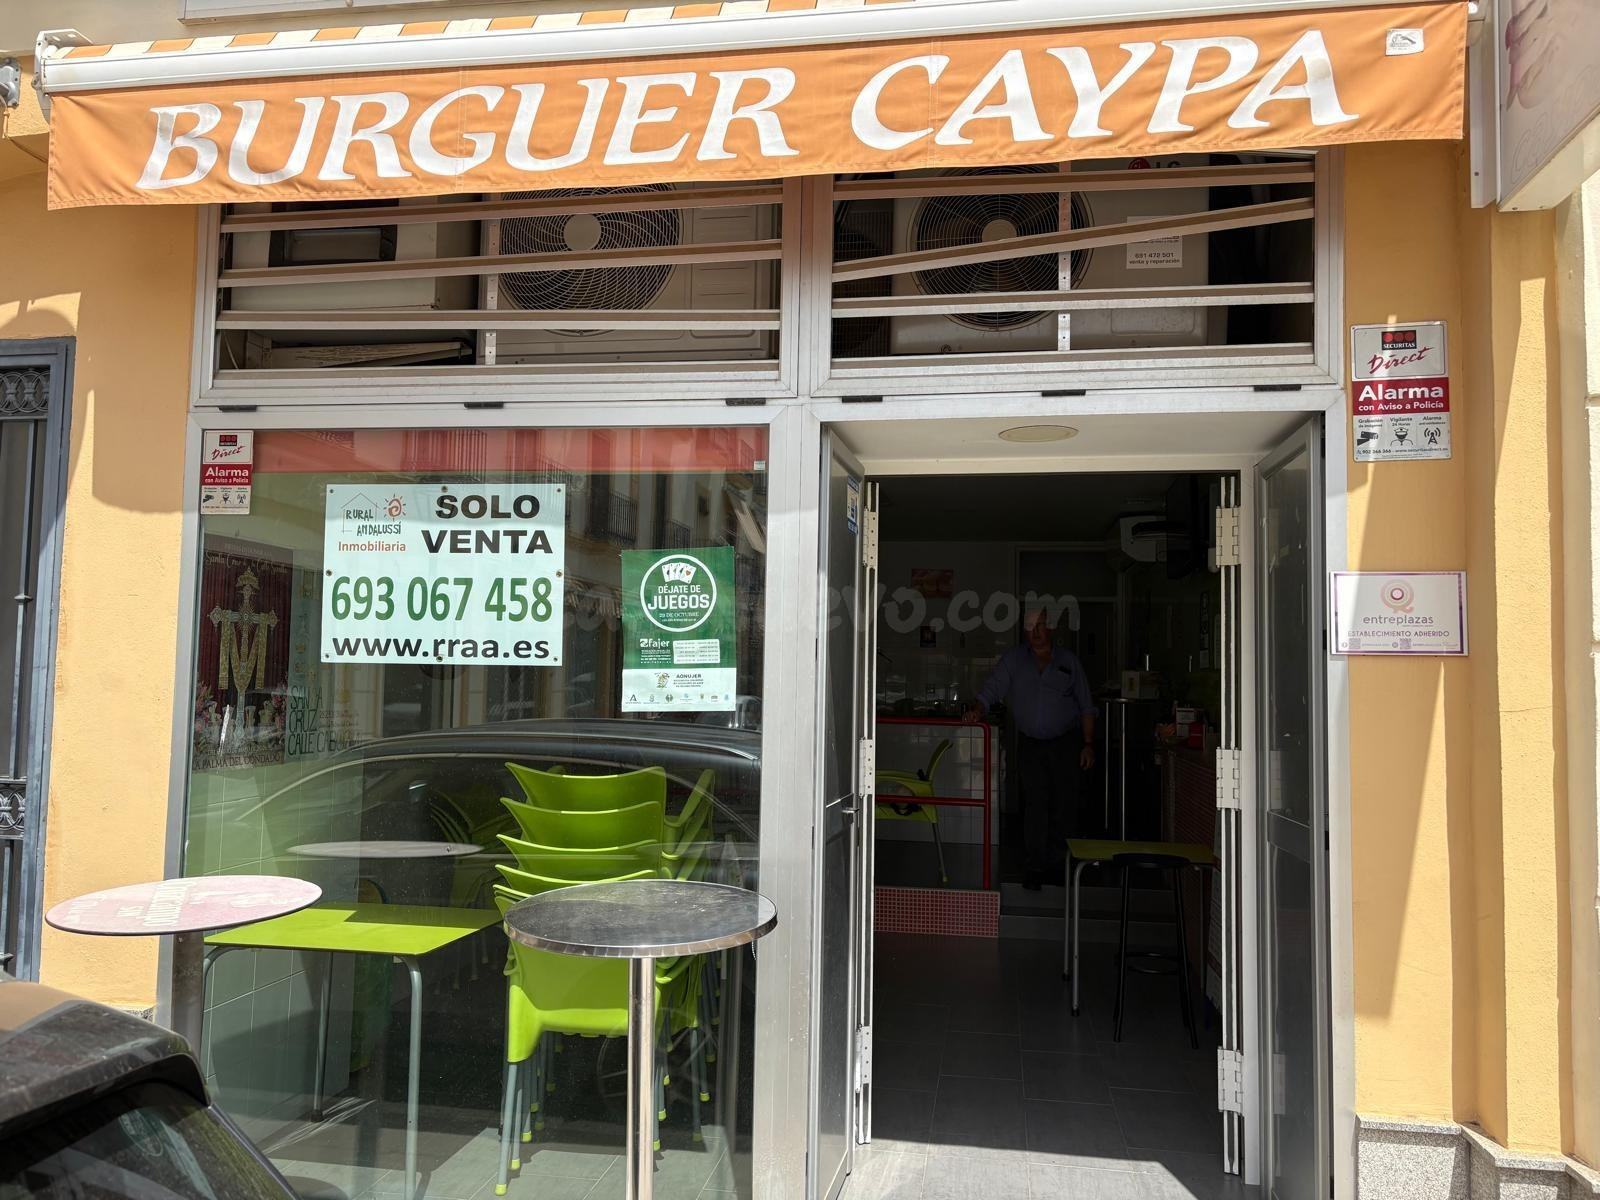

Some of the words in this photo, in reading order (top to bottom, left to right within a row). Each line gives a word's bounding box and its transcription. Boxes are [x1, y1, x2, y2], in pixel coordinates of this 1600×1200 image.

[134, 65, 801, 192] BURGUER
[849, 28, 1360, 151] CAYPA
[1367, 346, 1434, 375] Direct
[1358, 383, 1444, 402] Alarma
[1377, 403, 1403, 411] Aviso
[1413, 400, 1444, 410] Policía
[211, 445, 246, 461] Direct
[205, 466, 249, 477] Alarma
[345, 508, 374, 521] RURAL
[435, 494, 541, 519] SOLO
[356, 521, 402, 536] ANDALUSSÍ
[338, 541, 406, 552] Inmobiliaria
[421, 530, 553, 554] VENTA
[658, 584, 689, 594] DÉJATE
[690, 584, 702, 593] DE
[331, 576, 395, 621] 693
[406, 576, 473, 622] 067
[484, 577, 553, 622] 458
[647, 594, 711, 610] JUEGOS
[1362, 615, 1435, 626] entreplazas
[332, 637, 550, 659] www.rraa.es
[648, 638, 671, 649] fajer
[288, 709, 318, 733] CRUZ
[202, 757, 228, 769] PALMA
[229, 756, 243, 767] DEL
[244, 752, 281, 765] CONDADO
